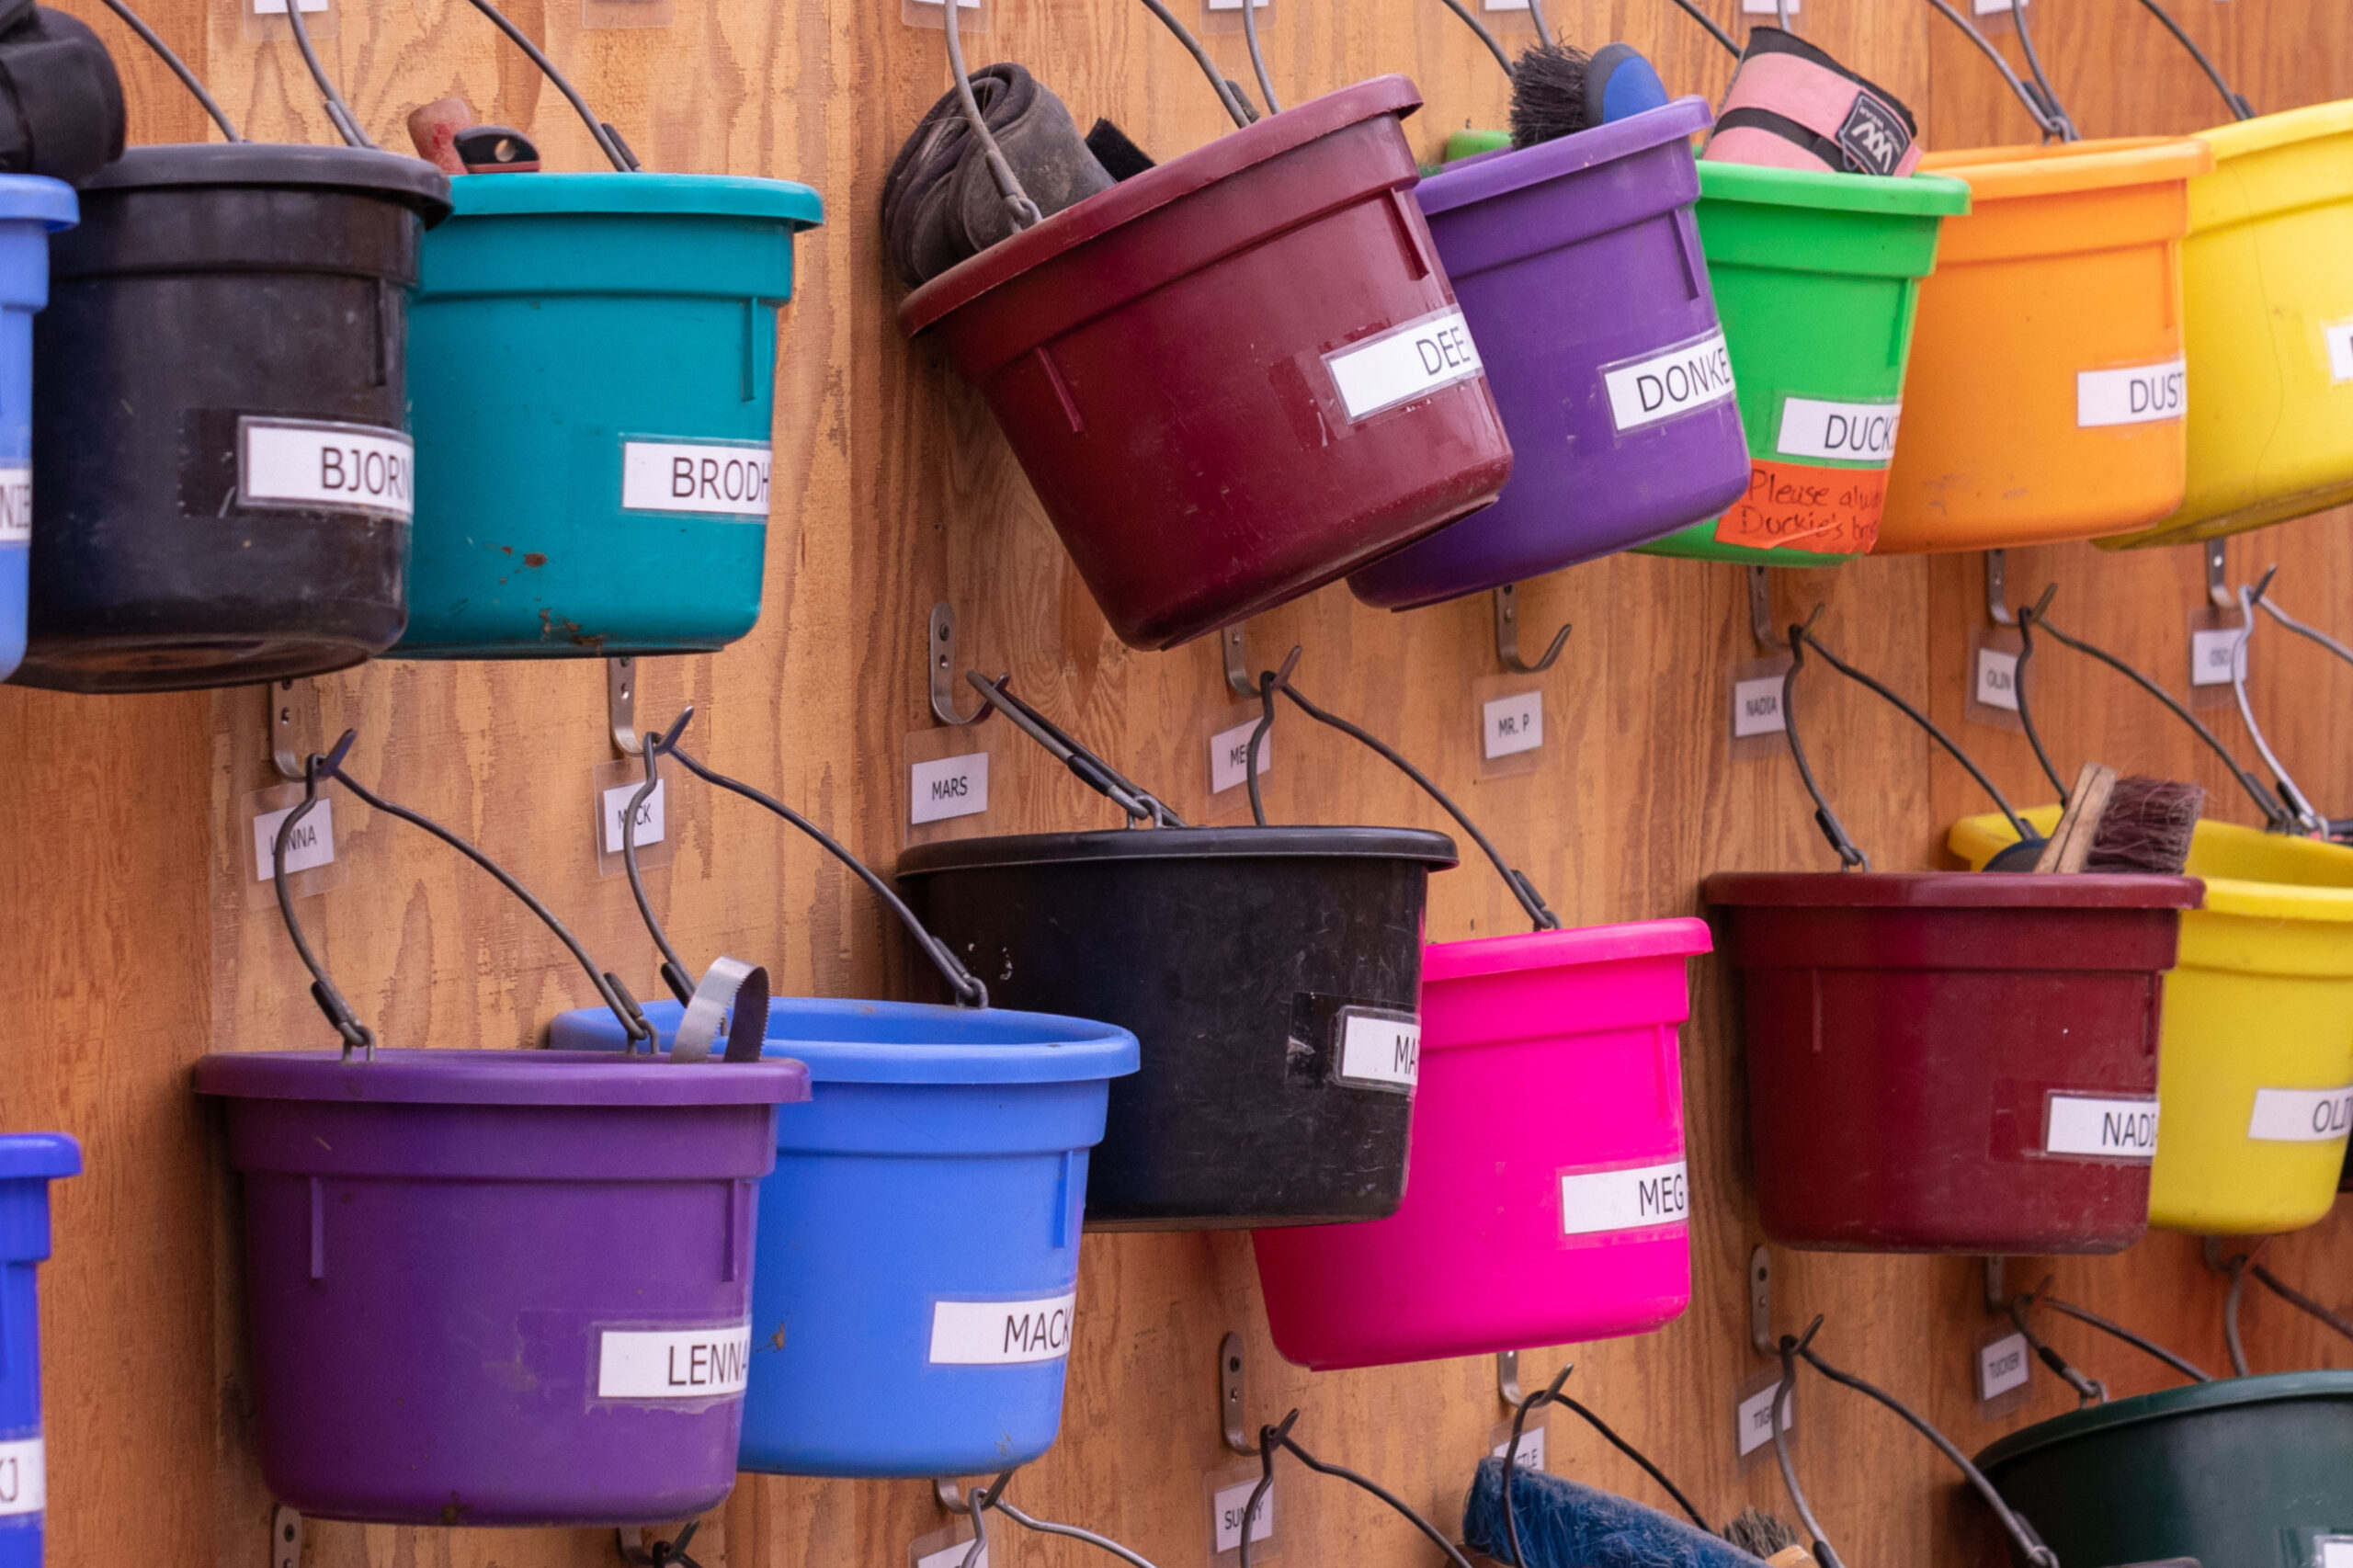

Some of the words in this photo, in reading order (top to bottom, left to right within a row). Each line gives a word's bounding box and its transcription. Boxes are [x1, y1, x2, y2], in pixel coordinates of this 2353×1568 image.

[1415, 326, 1471, 376] DEE
[1636, 347, 1731, 413] DONKE
[1747, 469, 1830, 506] Please
[1497, 716, 1519, 738] MR.
[1522, 712, 1530, 733] P
[1230, 740, 1251, 768] ME
[931, 775, 969, 801] MARS
[618, 802, 652, 830] MCK
[269, 824, 318, 857] LNNA
[1394, 1034, 1420, 1076] MA
[2102, 1111, 2158, 1148] NADI
[1638, 1173, 1684, 1217] MEG
[1004, 1305, 1074, 1354] MACK
[1753, 1405, 1774, 1431] TIG
[1224, 1500, 1264, 1531] SUY
